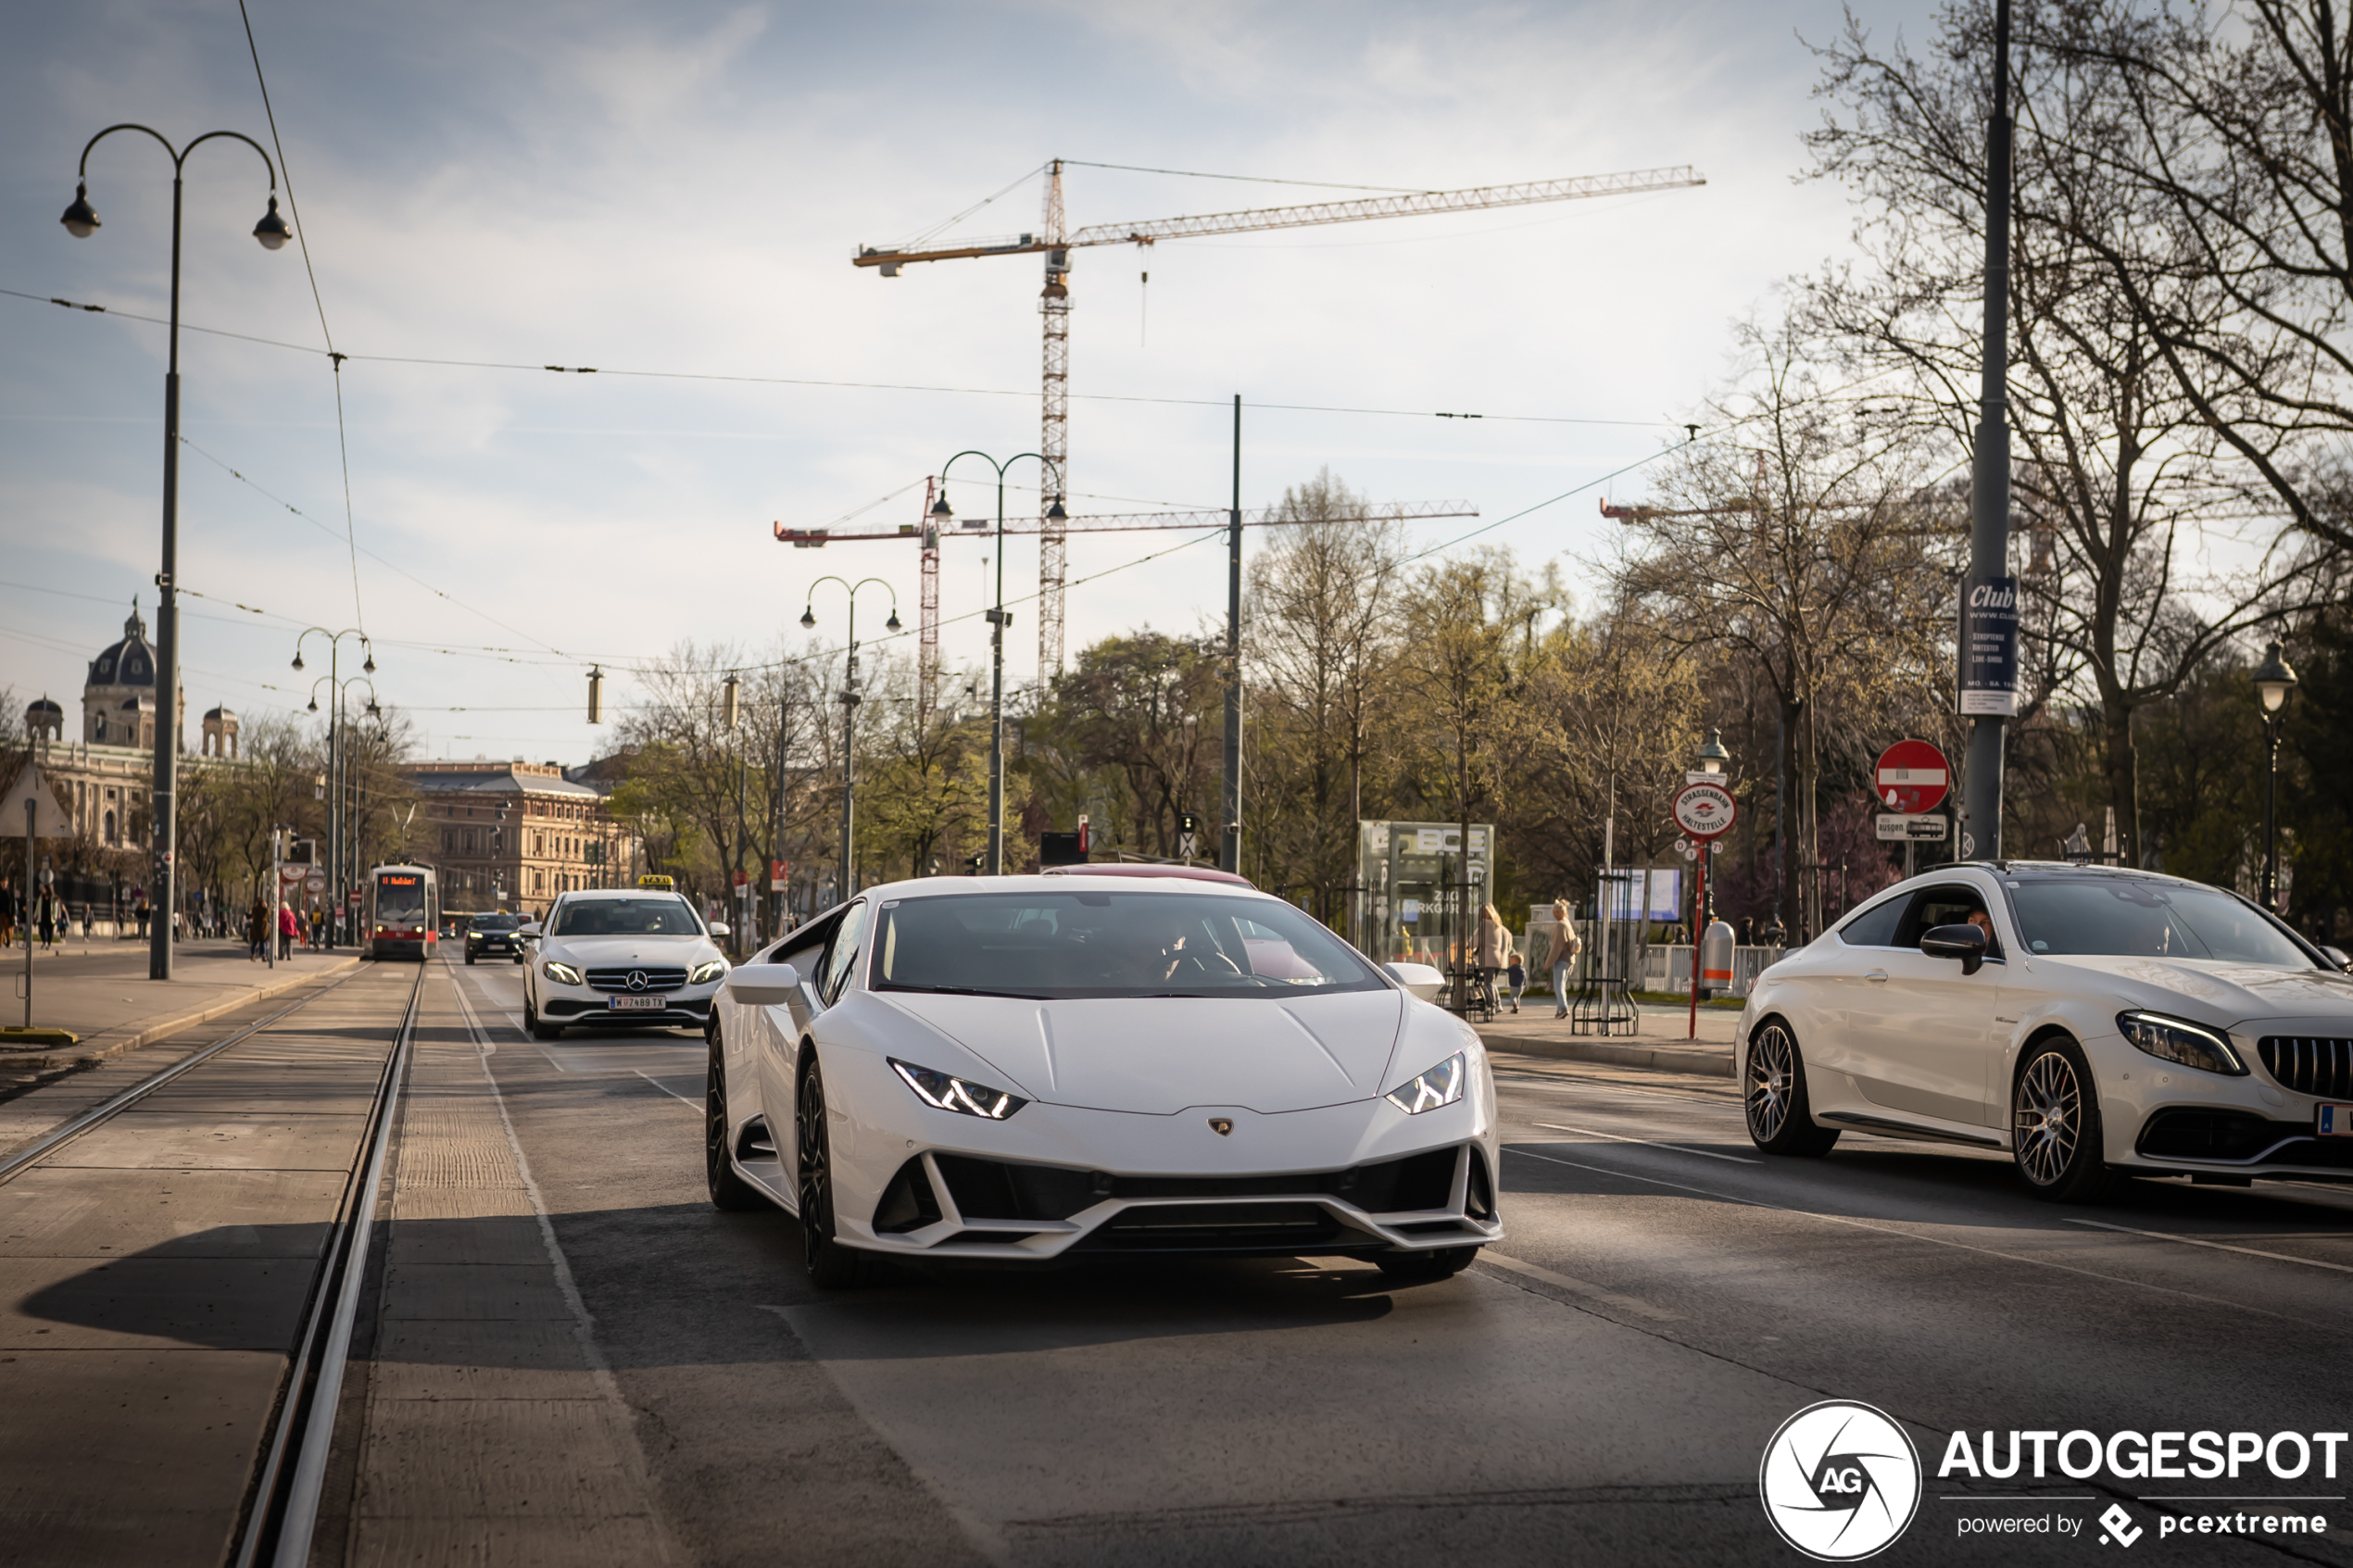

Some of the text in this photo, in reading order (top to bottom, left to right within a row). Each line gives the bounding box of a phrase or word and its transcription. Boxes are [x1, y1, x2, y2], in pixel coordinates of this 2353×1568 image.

[1969, 584, 2014, 608] Club
[1681, 789, 1730, 809] STRASSENBAHN
[1682, 814, 1727, 831] HALTESTELLE
[1879, 823, 1905, 833] ausgen.
[1677, 841, 1684, 849] D
[1713, 843, 1722, 851] 71
[616, 997, 622, 1007] W
[652, 997, 663, 1007] TX
